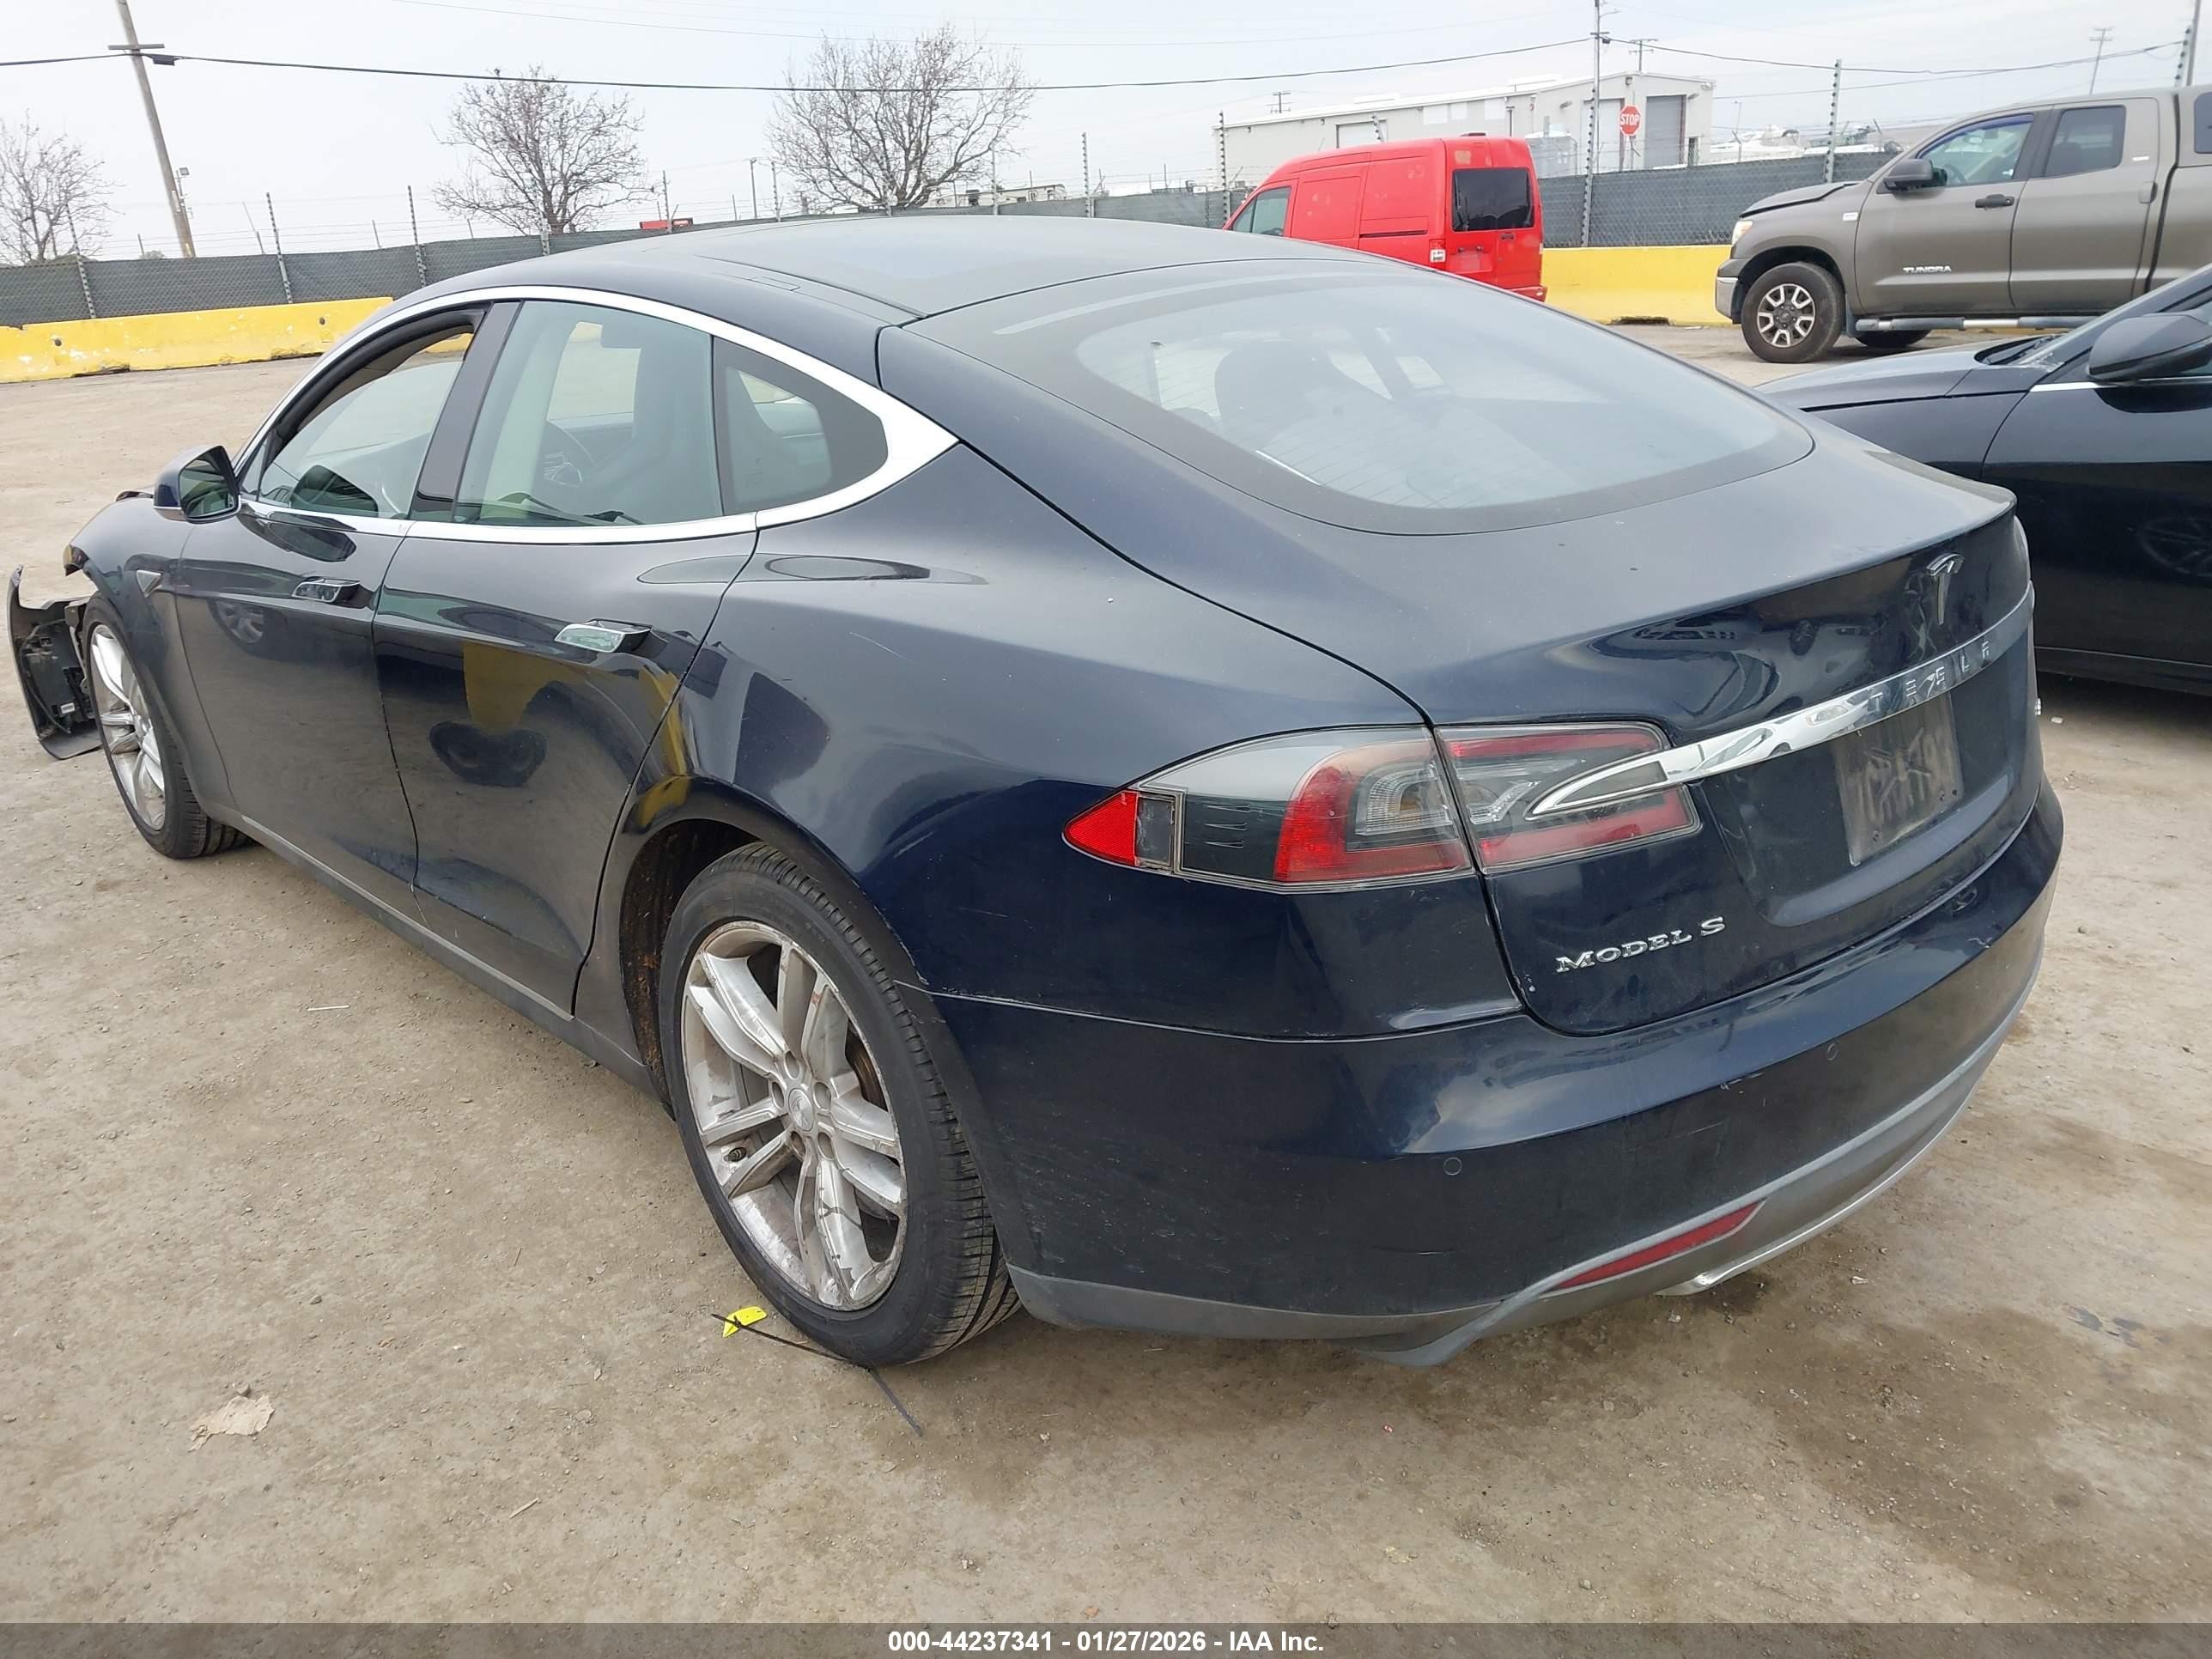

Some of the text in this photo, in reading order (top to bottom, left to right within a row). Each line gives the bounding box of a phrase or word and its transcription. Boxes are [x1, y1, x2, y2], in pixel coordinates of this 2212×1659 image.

[1620, 113, 1640, 126] STOP
[1903, 265, 1952, 274] TUNDRA
[1555, 916, 1726, 973] MODEL S
